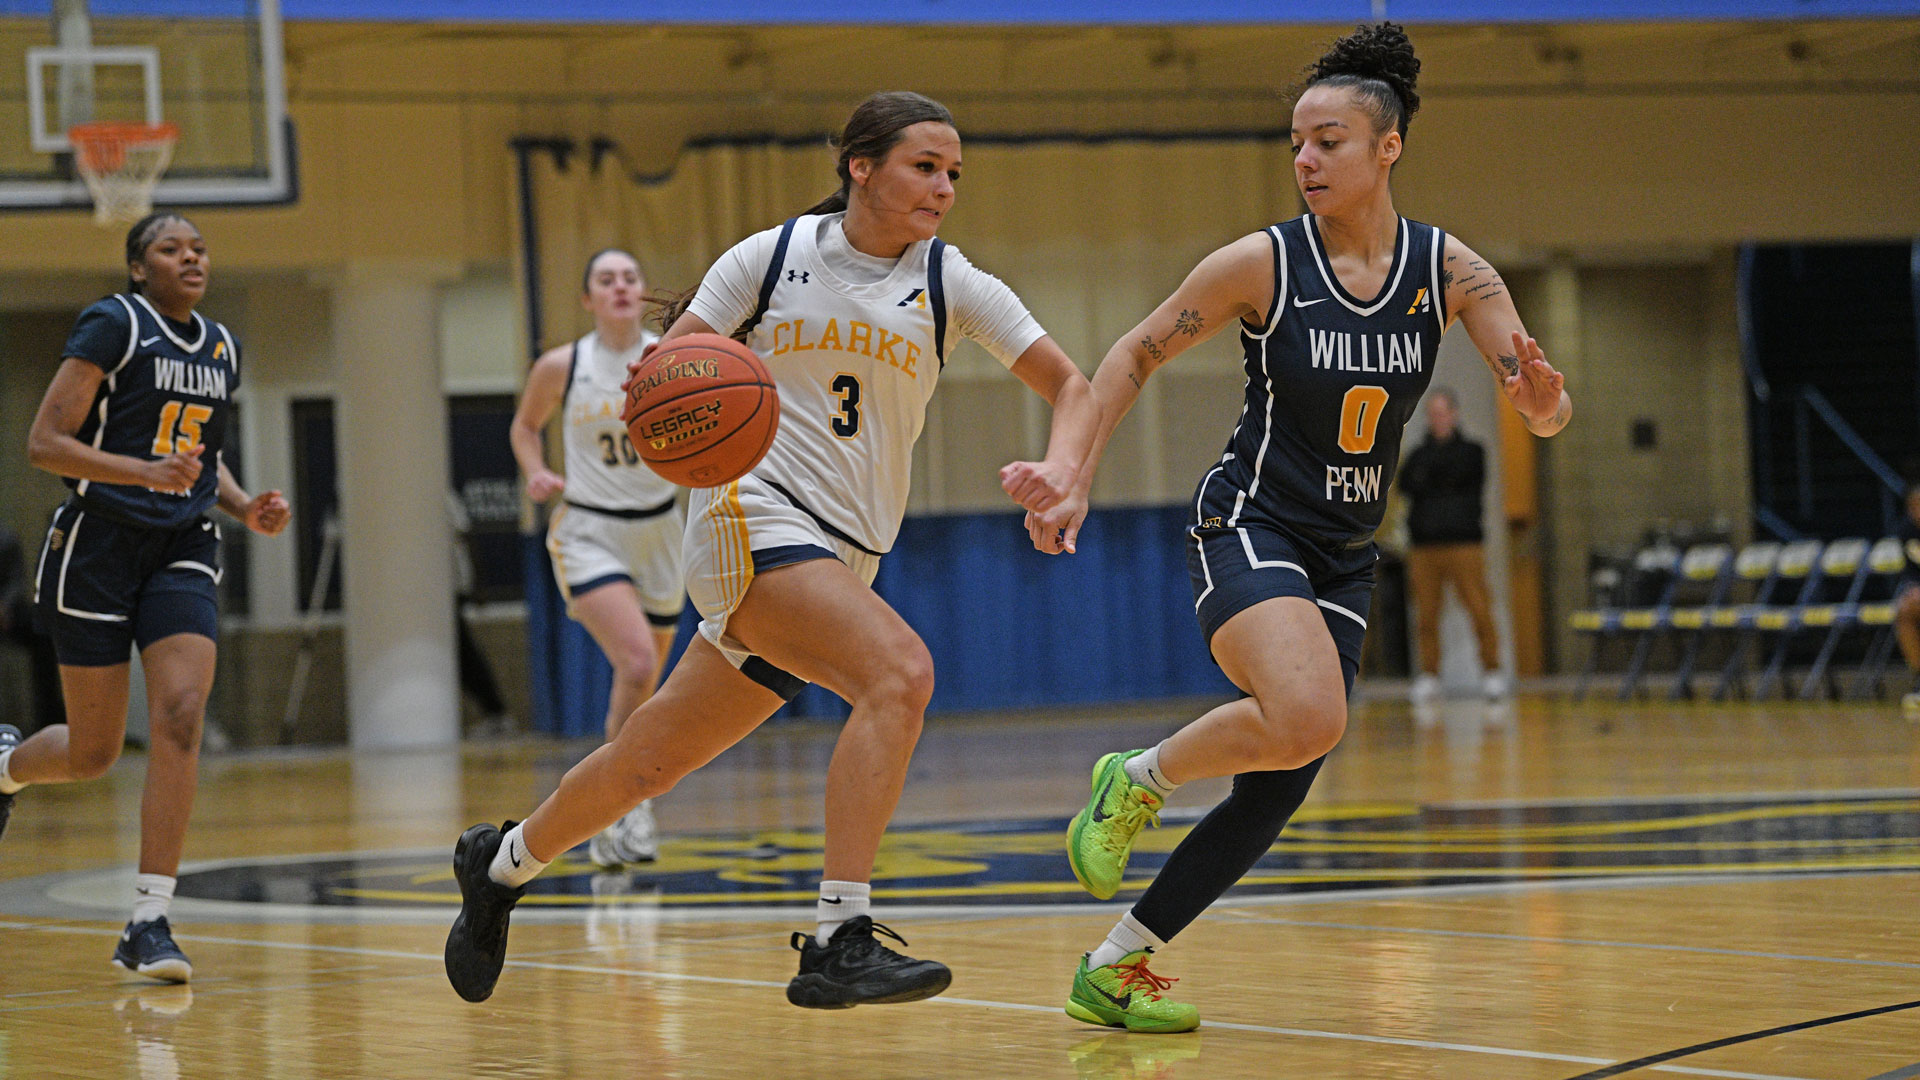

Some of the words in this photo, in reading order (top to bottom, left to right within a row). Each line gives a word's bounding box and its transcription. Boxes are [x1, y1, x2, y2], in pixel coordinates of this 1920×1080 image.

[773, 318, 922, 380] CLARKE
[1141, 335, 1167, 363] 2001
[1309, 328, 1423, 374] WILLIAM
[154, 356, 227, 401] WILLIAM
[631, 358, 719, 408] SPALDING
[151, 400, 214, 457] 15
[640, 400, 722, 440] LEGACY
[828, 371, 864, 441] 3
[1337, 385, 1390, 455] 0
[597, 430, 639, 467] 30
[668, 420, 719, 444] 1000
[1326, 464, 1382, 503] PENN
